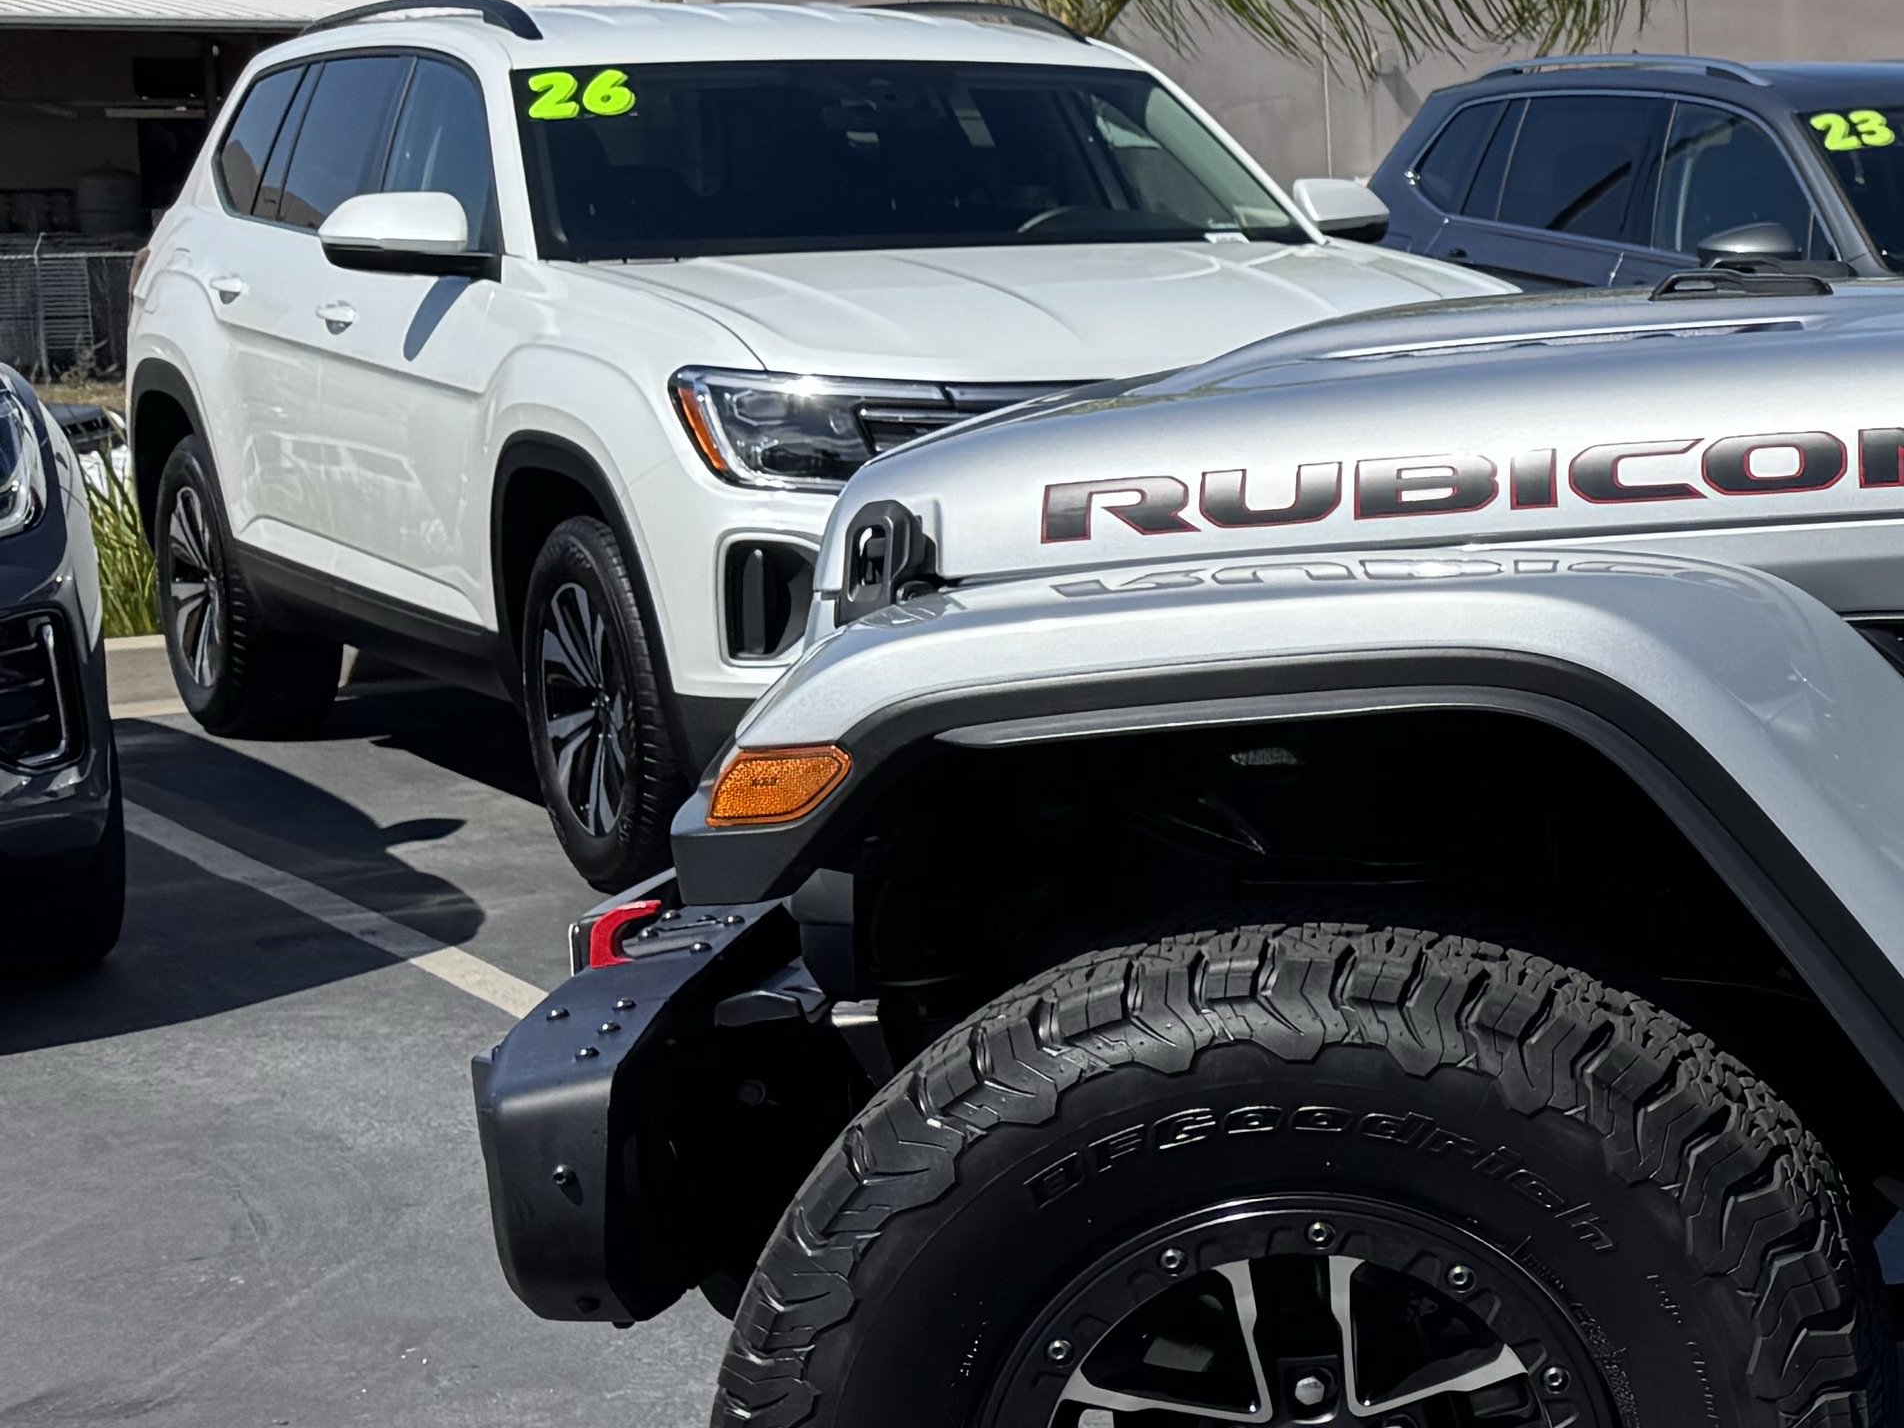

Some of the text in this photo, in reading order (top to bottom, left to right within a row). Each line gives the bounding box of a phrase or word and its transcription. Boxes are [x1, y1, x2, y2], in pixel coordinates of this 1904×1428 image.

[528, 69, 636, 120] 26
[1809, 110, 1896, 150] 23
[1023, 1104, 1618, 1254] BFGoodrich
